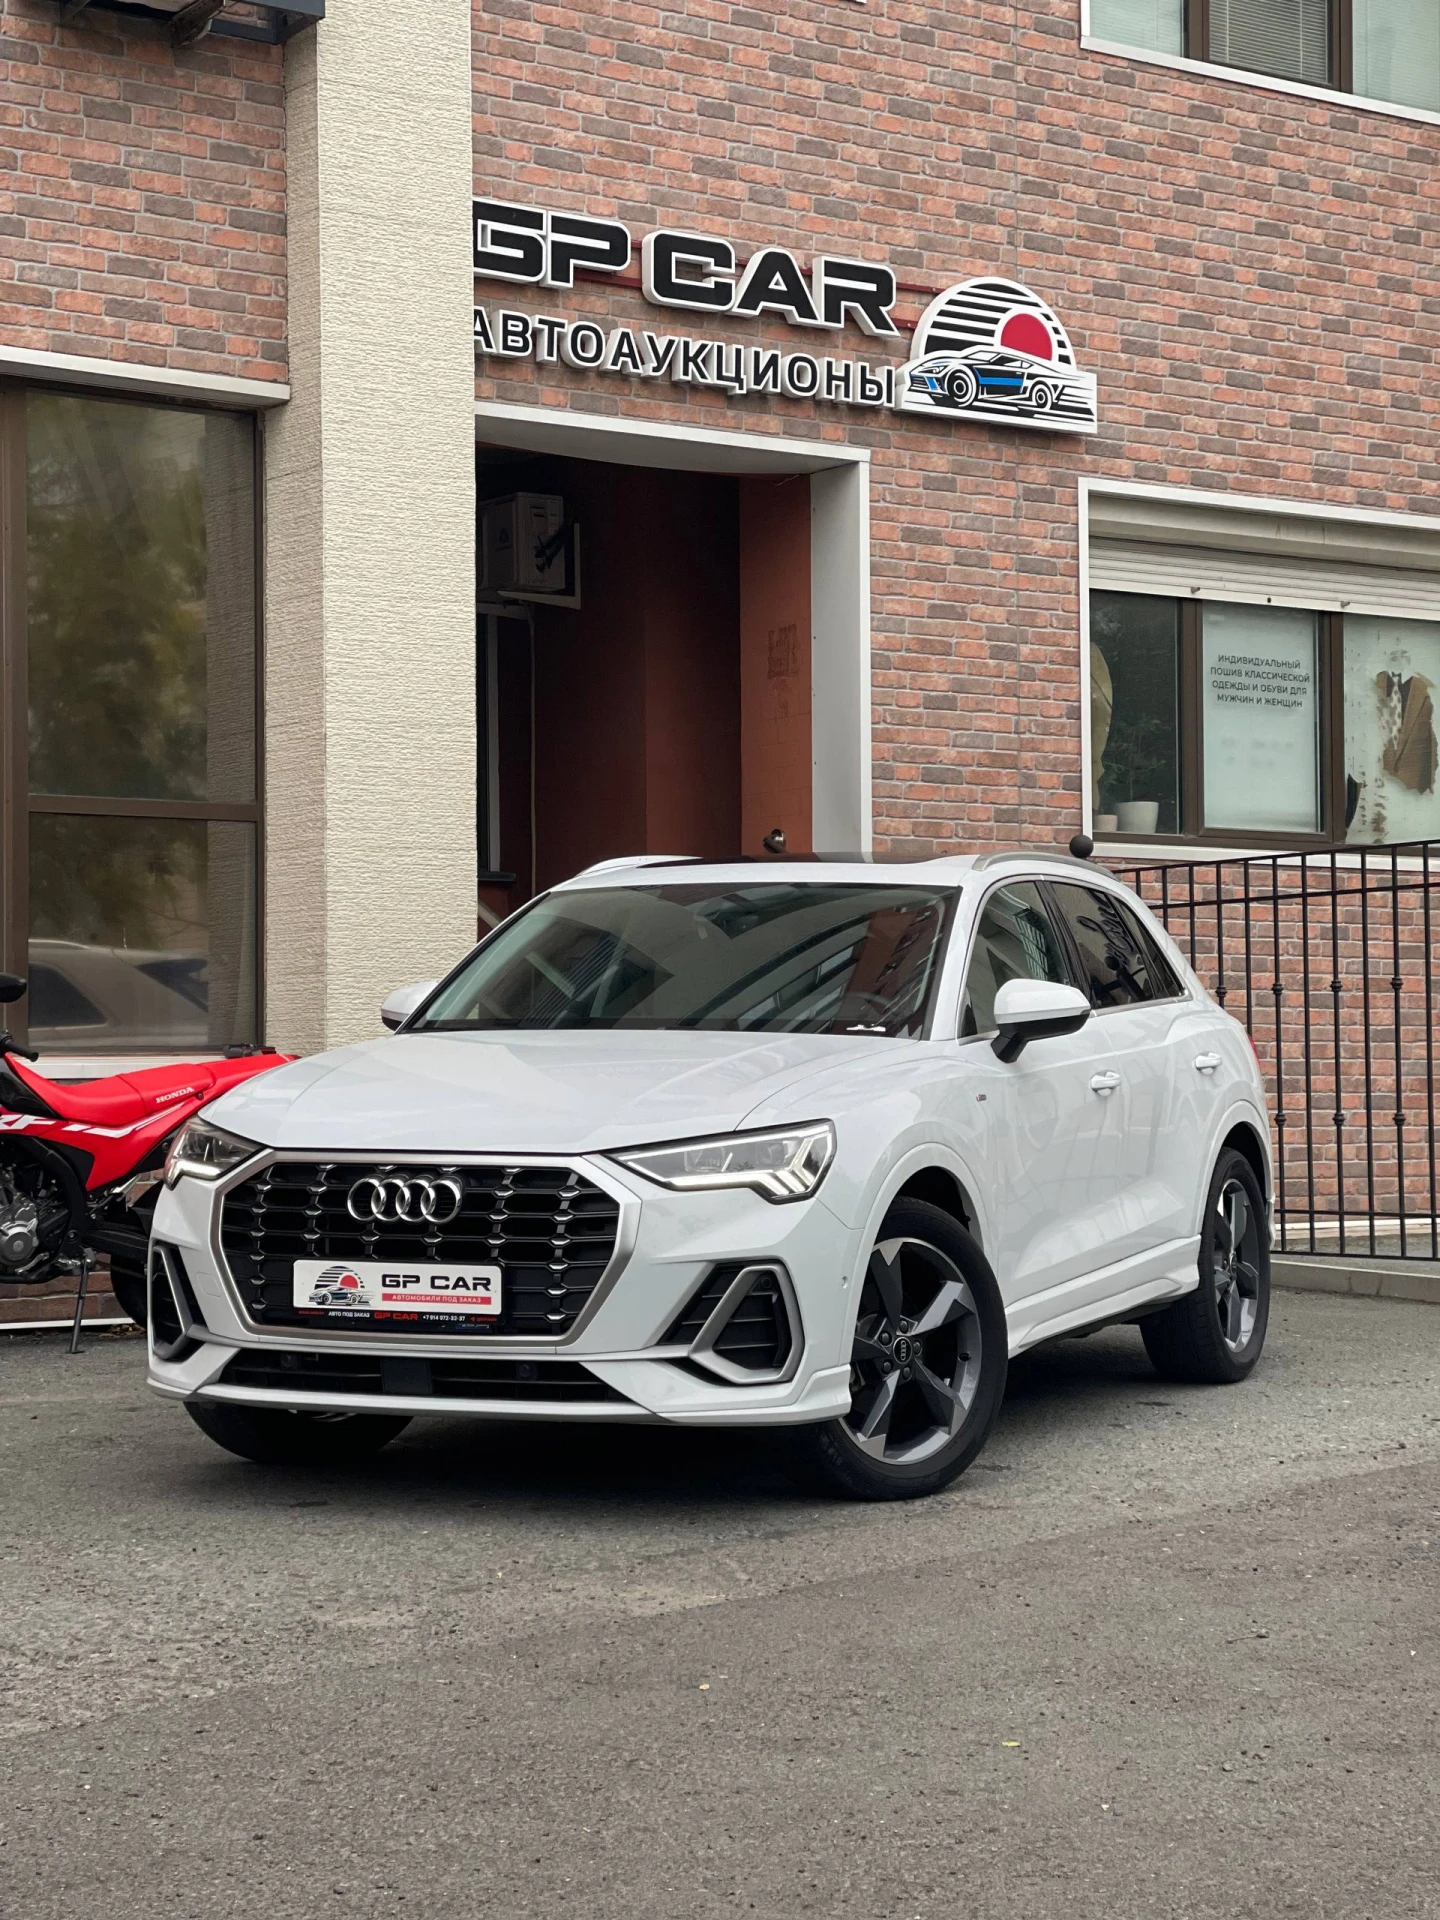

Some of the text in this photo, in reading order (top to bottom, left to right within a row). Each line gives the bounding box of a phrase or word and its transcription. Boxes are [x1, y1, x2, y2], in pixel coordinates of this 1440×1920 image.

[473, 198, 900, 337] GP CAR
[474, 306, 896, 408] АВТОАУКЦИОНЫ
[1218, 654, 1301, 669] ИНДИВИДУАЛЬНЫЙ
[1210, 666, 1310, 683] ПОШИВ КЛАССИЧЕСКОЙ
[1212, 680, 1307, 695] ОДЕЖДЫ И ОБУВИ ДЛЯ
[1217, 693, 1303, 708] МУЖЧИН И ЖЕНЩИН
[155, 1086, 195, 1104] HONDA
[381, 1273, 492, 1291] GP CAR
[391, 1293, 441, 1302] АВТОМОБИЛИ
[459, 1296, 482, 1304] ЗАКАЗ
[392, 1312, 418, 1320] CAR
